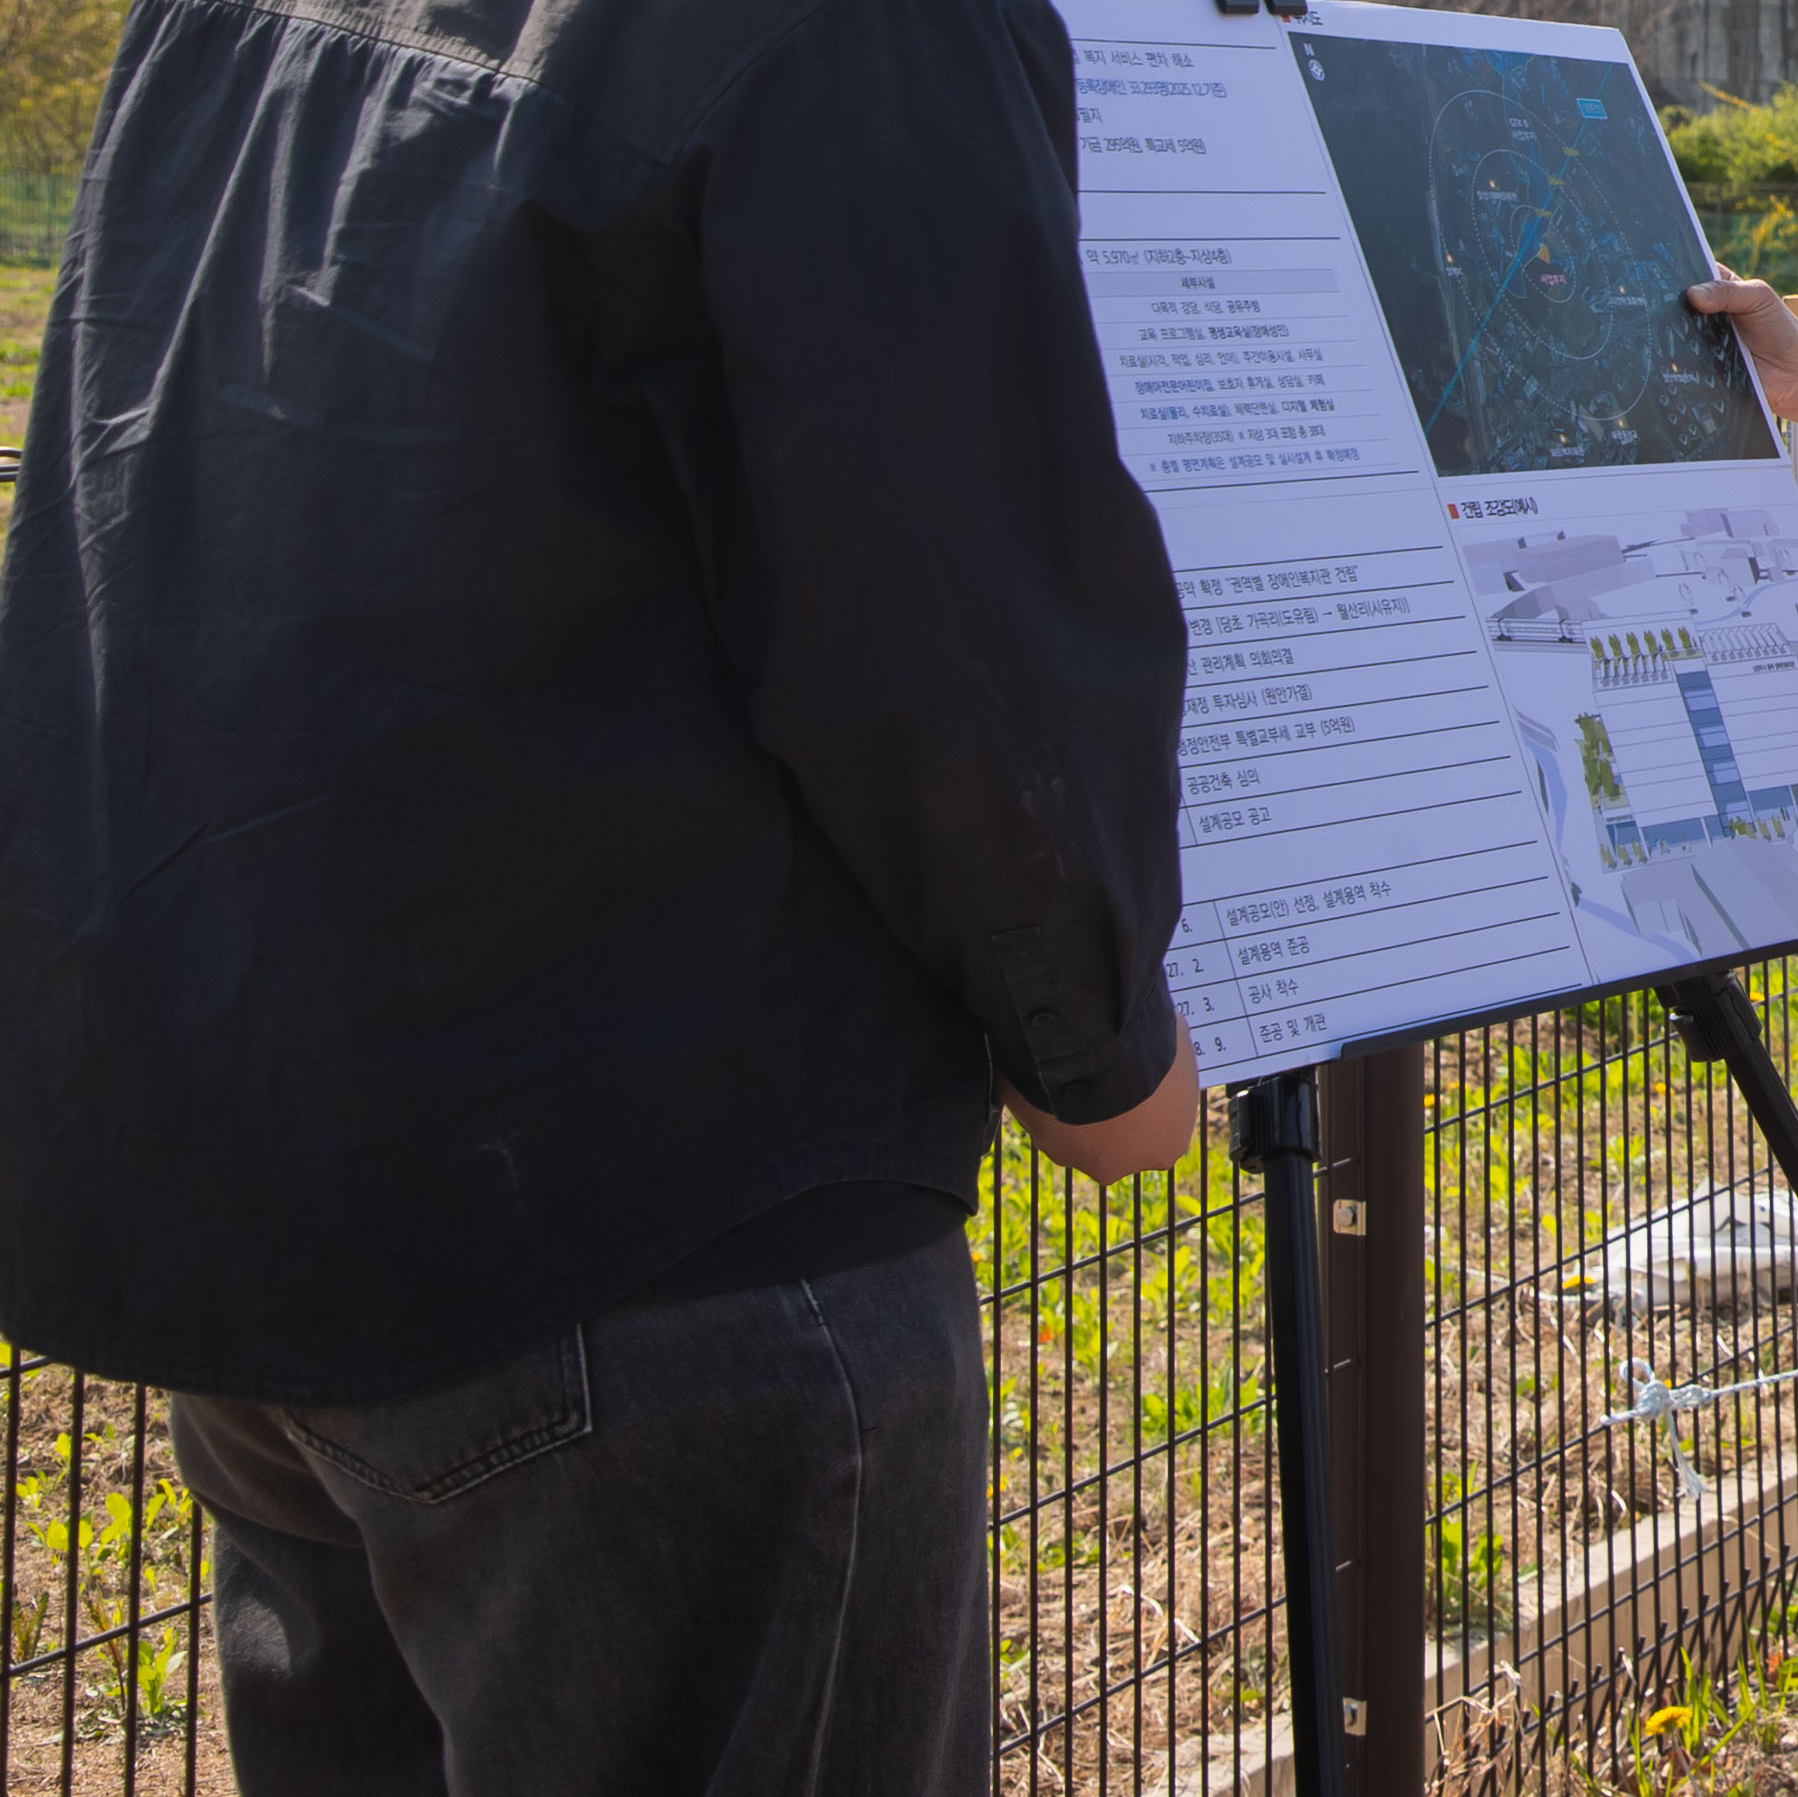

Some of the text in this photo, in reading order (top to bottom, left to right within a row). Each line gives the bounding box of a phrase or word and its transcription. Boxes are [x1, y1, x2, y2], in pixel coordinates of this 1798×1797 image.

[1084, 50, 1107, 66] 복지
[1112, 51, 1143, 66] 서비스
[1145, 52, 1169, 68] 편차
[1172, 53, 1195, 68] 해소
[1304, 42, 1315, 57] N
[1080, 136, 1102, 153] 기금
[1086, 249, 1099, 265] 약
[1181, 277, 1216, 289] 세부시설
[1138, 327, 1158, 341] 교육
[1461, 497, 1538, 519] 건립 조감도(예시)
[1200, 578, 1224, 596] 확정
[1268, 568, 1332, 590] 장애인복지관
[1190, 618, 1213, 636] 변경
[1249, 607, 1319, 631] 가곡리(도유림)
[1201, 654, 1246, 675] 관리계획
[1249, 648, 1294, 667] 의회의결
[1182, 683, 1313, 717] 재정 투자심사 (원안가결)
[1235, 724, 1292, 748] 특별교부세
[1294, 721, 1316, 739] 교부
[1320, 716, 1355, 737] (5억원)
[1186, 768, 1260, 795] 공공건축 심의
[1199, 806, 1272, 833] 설계공모 공고
[1226, 898, 1290, 927] 설계공모(안)
[1322, 885, 1367, 909] 설계용역
[1369, 879, 1392, 899] 착수
[1181, 918, 1193, 933] 6.
[1237, 935, 1310, 966] 설계용역 준공
[1203, 996, 1215, 1012] 3.
[1248, 977, 1299, 1004] 공사 착수
[1259, 1012, 1328, 1043] 준공 및 개관
[1214, 1036, 1226, 1052] 9.
